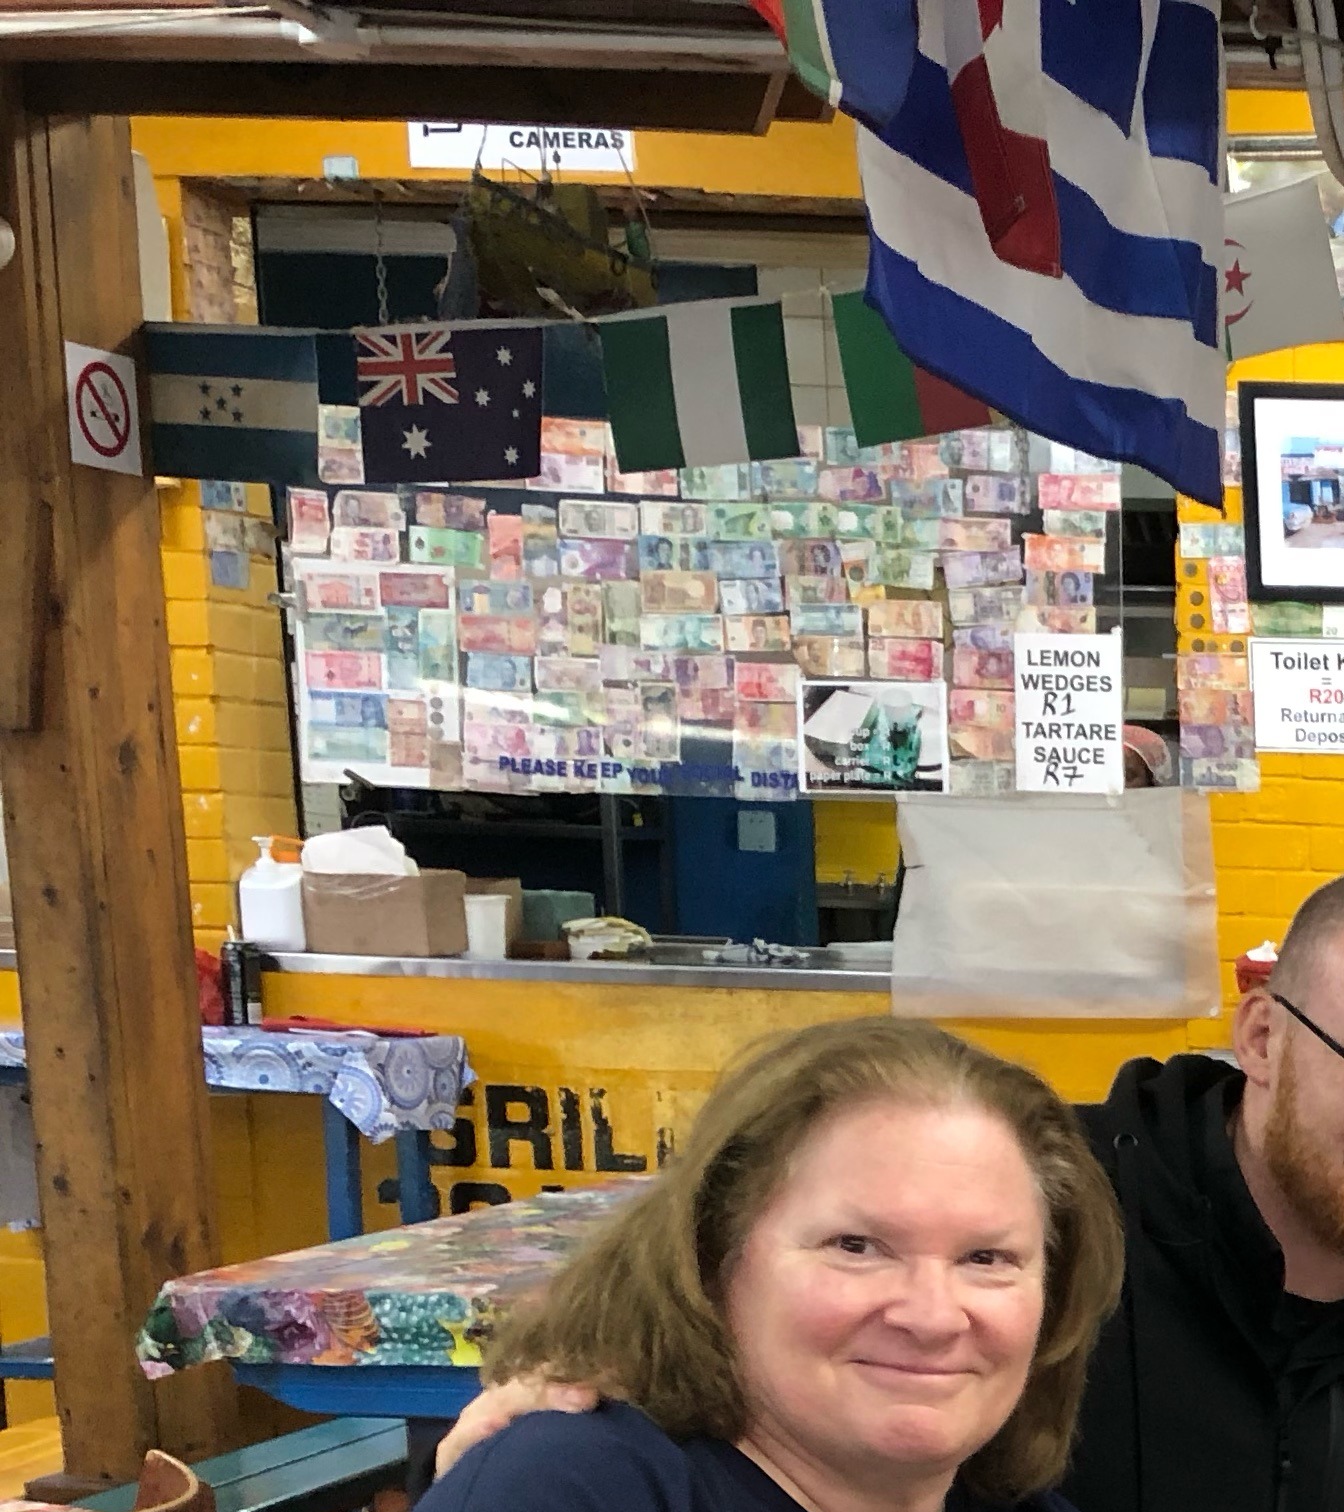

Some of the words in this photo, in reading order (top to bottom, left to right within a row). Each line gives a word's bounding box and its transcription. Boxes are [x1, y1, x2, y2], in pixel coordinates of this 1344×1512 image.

[509, 131, 624, 149] CAMERAS
[1027, 649, 1100, 668] LEMON
[1270, 651, 1330, 671] Toilet
[1020, 673, 1112, 692] WEDGES
[1042, 691, 1076, 716] R1
[1309, 688, 1344, 704] R20
[1021, 721, 1117, 741] TARTARE
[1033, 746, 1105, 765] SAUCE
[498, 755, 567, 777] PLEASE
[573, 759, 623, 779] KEEP
[1043, 761, 1084, 787] R7
